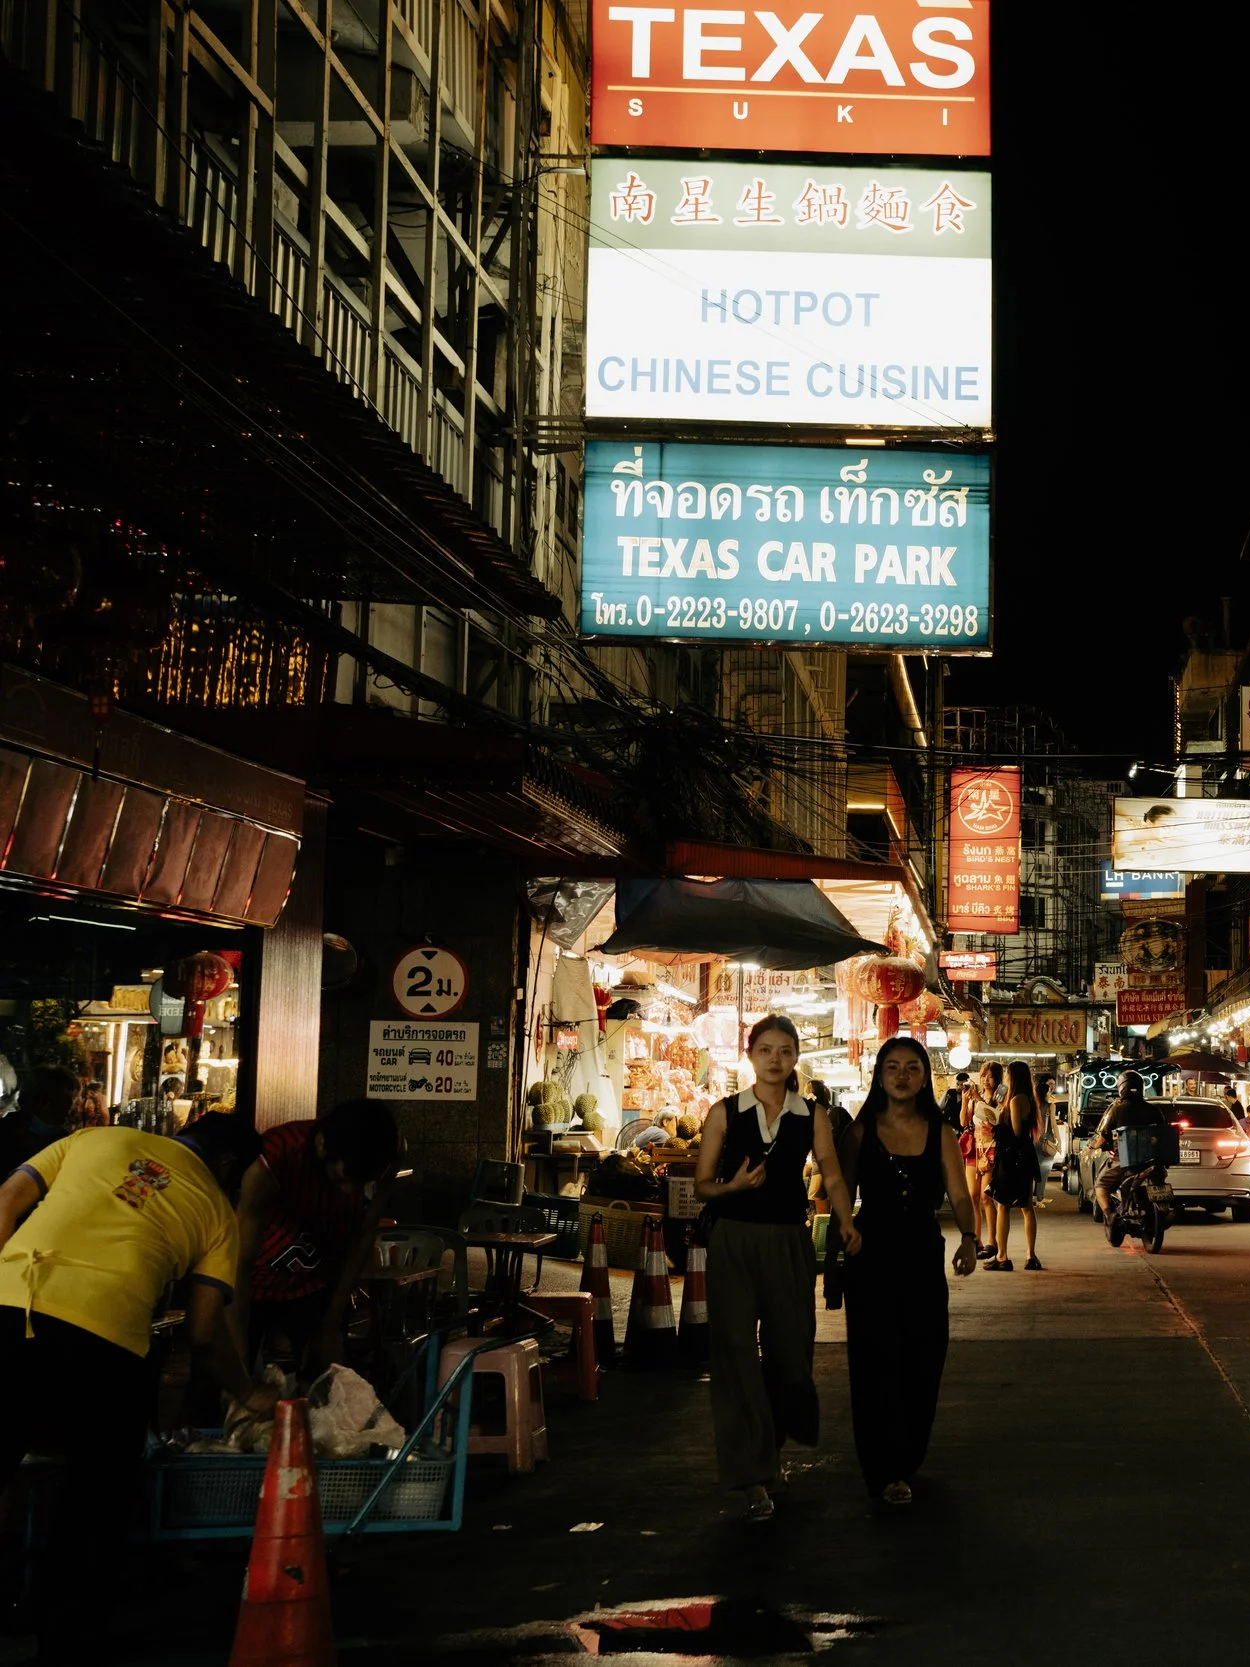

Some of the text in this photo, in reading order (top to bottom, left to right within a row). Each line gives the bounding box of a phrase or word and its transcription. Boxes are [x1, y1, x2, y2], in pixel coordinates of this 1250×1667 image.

[608, 7, 976, 89] TEXAS
[701, 288, 880, 327] HOTPOT
[597, 355, 980, 401] CHINESE CUISINE
[610, 447, 969, 528] ที่จอดรถ เท็กซัส
[617, 536, 958, 586] TEXAS CAR PARK
[820, 603, 979, 637] 0-2623-3298
[966, 855, 993, 863] BIRD'S
[1105, 870, 1175, 881] LH BANK
[406, 966, 458, 997] 2 ม.
[383, 1024, 466, 1039] ค่าบริการจอดรถ
[380, 1058, 397, 1066] CAR
[436, 1050, 454, 1066] 40
[369, 1084, 406, 1093] MOTORCYCLE
[435, 1077, 453, 1093] 20
